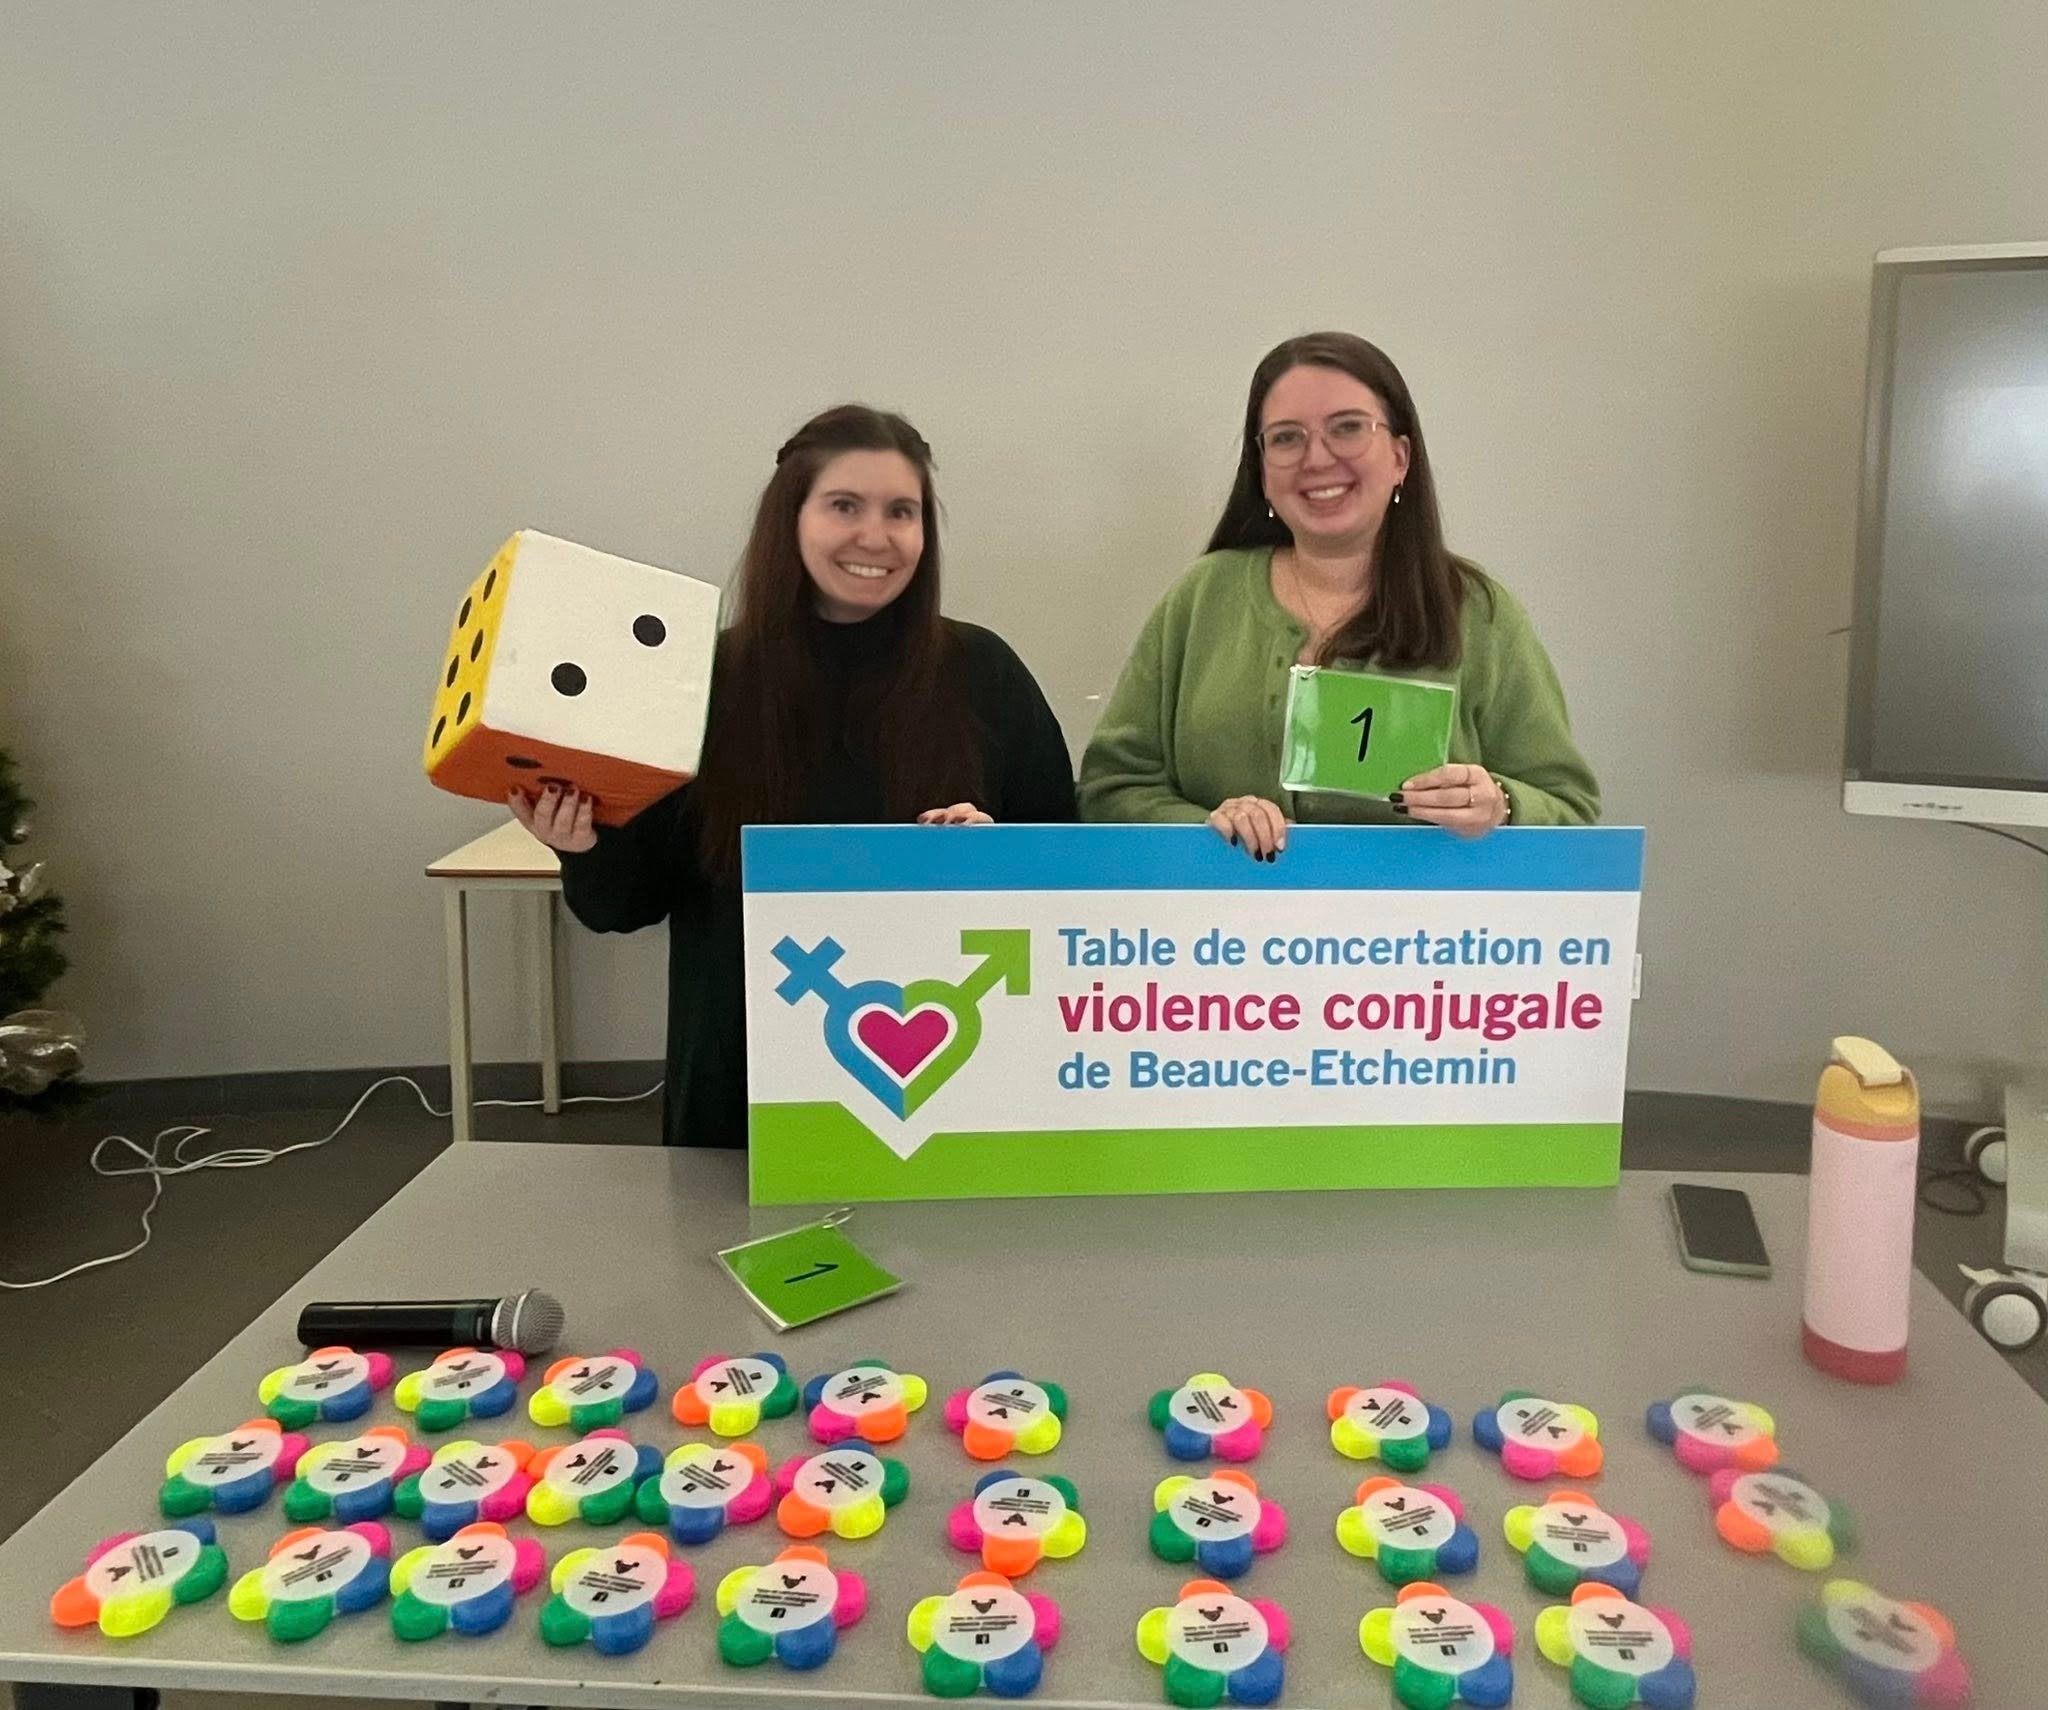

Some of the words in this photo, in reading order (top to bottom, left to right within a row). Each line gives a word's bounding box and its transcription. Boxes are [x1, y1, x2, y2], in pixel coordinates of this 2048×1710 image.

[1350, 707, 1373, 762] 1
[1059, 929, 1175, 965] Table
[1195, 931, 1245, 965] de
[1264, 928, 1541, 964] concertation
[1560, 939, 1609, 964] en
[1059, 982, 1300, 1032] violence
[1324, 981, 1602, 1041] conjugale
[1059, 1053, 1109, 1088] de
[1131, 1048, 1515, 1087] Beauce-Etchemin
[784, 1263, 839, 1284] 1
